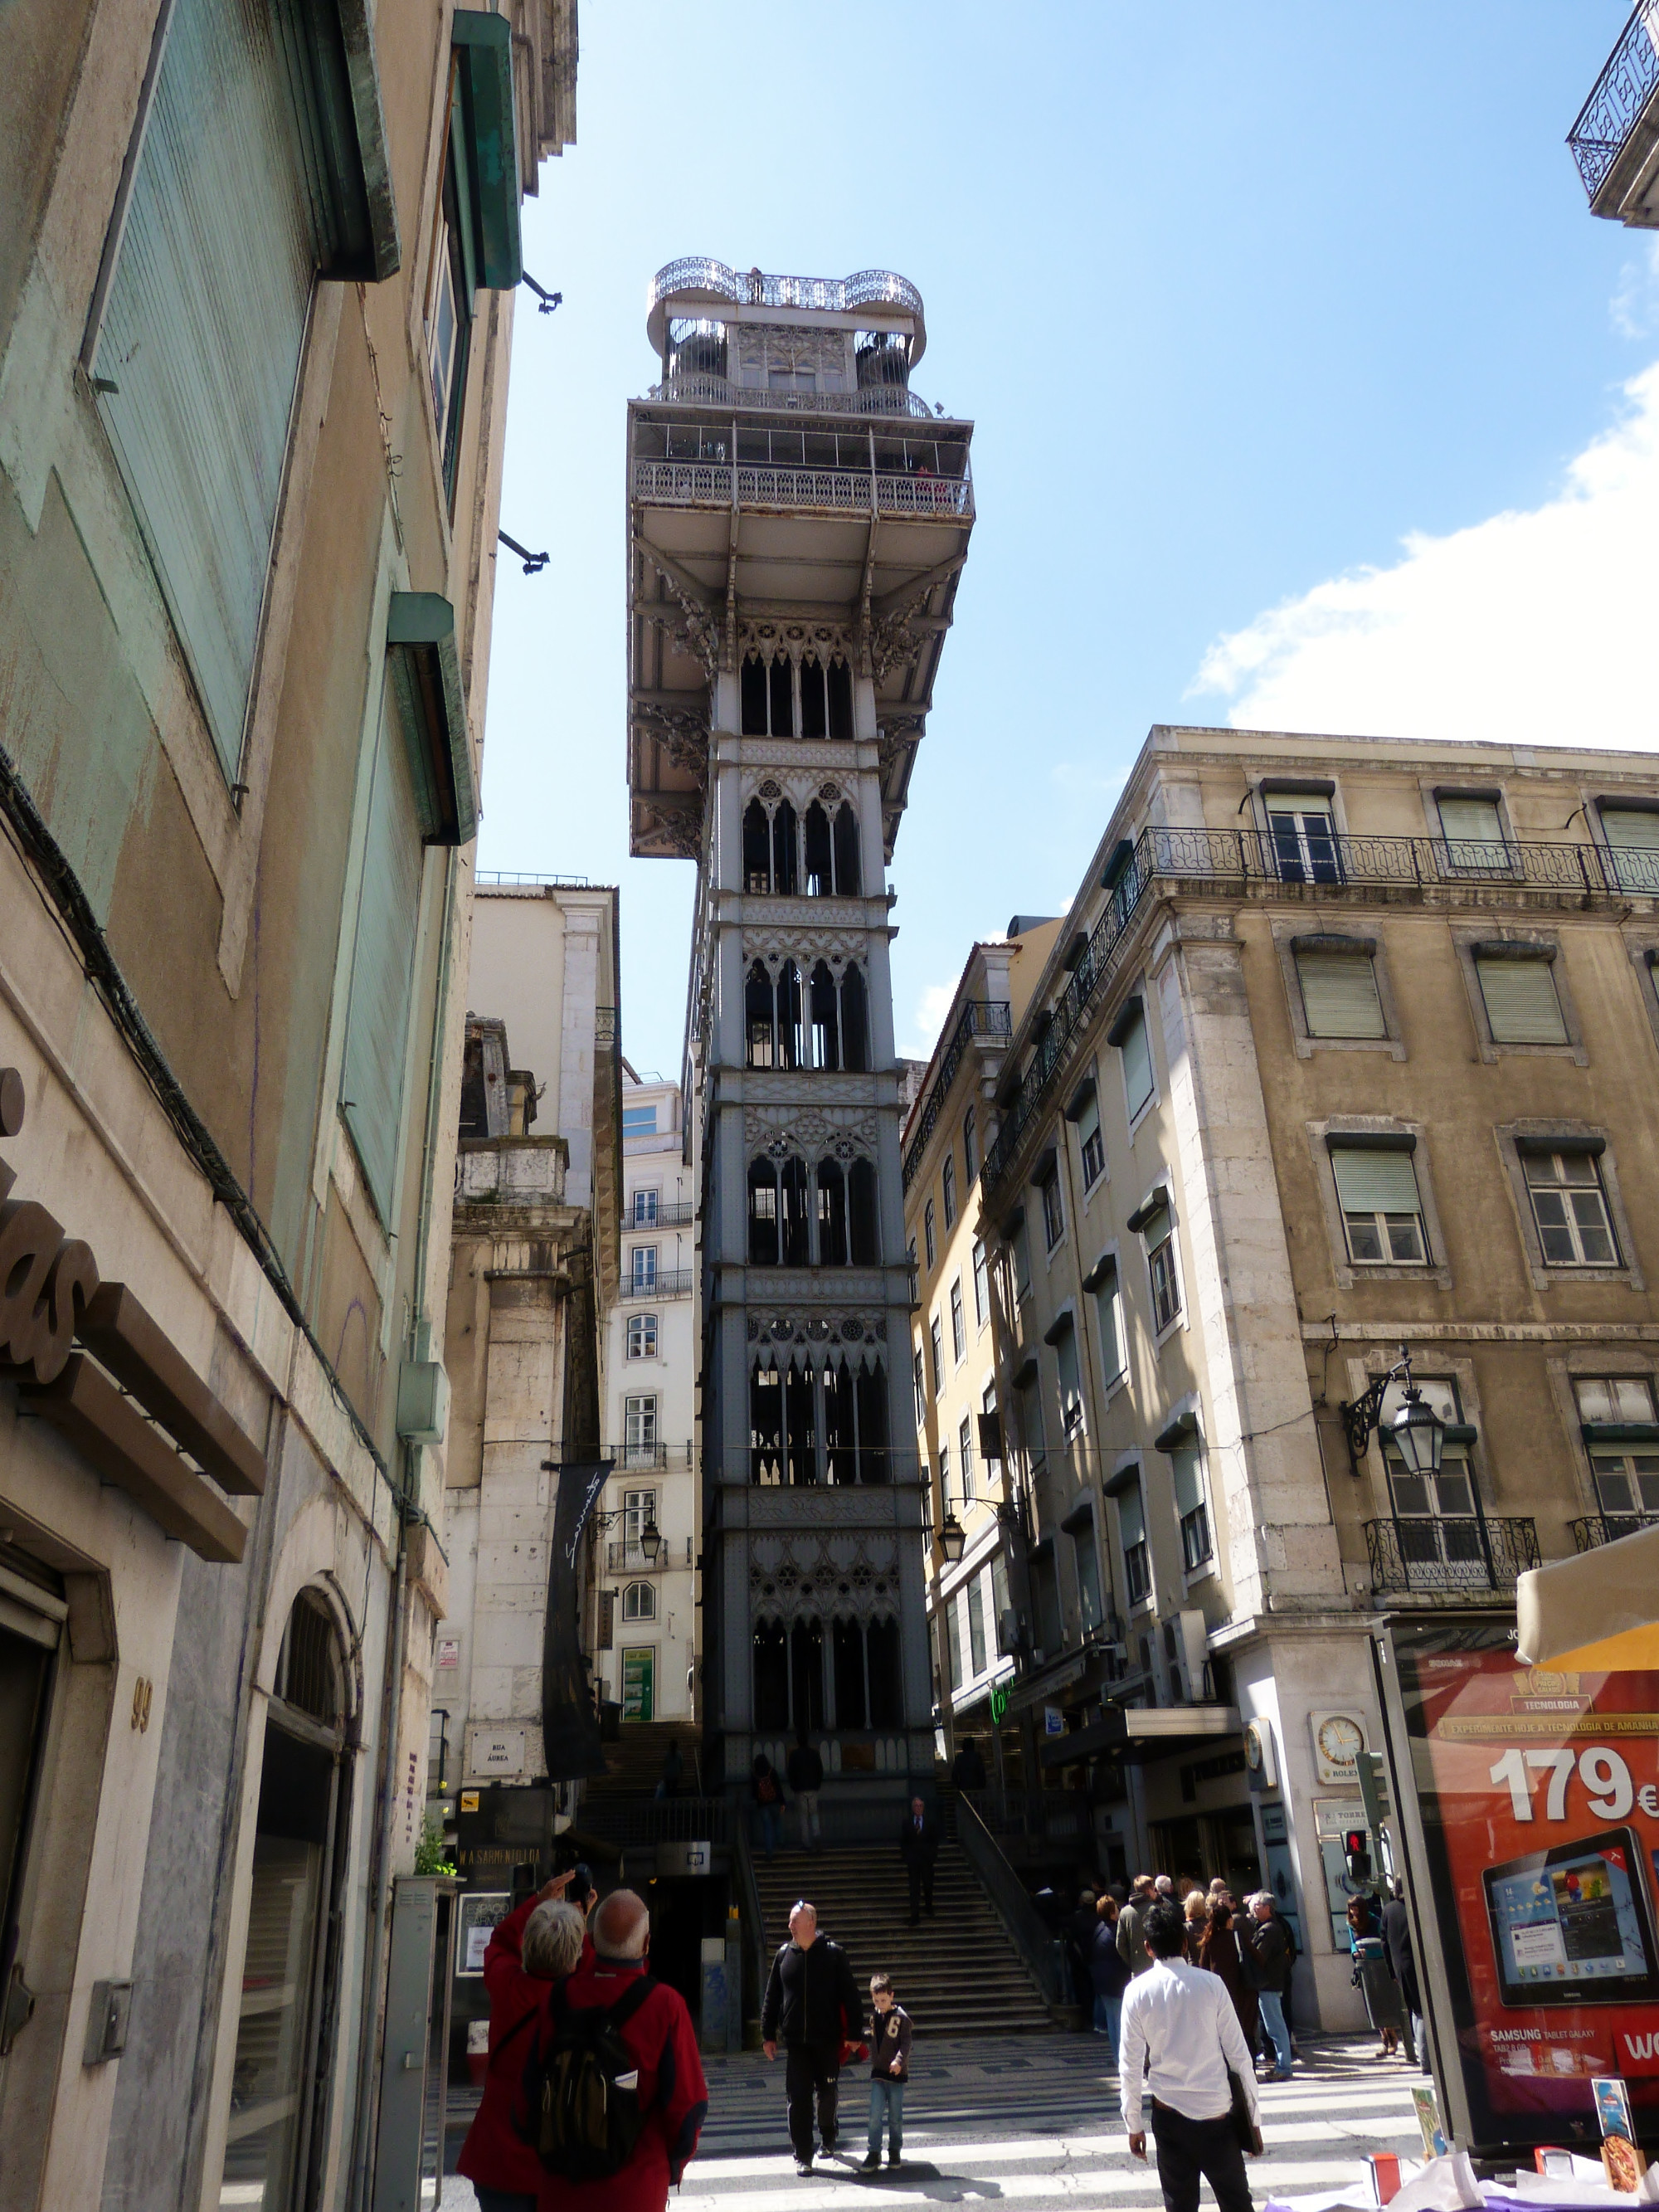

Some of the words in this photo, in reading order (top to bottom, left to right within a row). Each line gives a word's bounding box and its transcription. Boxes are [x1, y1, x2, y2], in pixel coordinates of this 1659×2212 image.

[131, 1676, 153, 1734] 99
[1525, 1700, 1579, 1710] TECNOLOGIA
[1452, 1725, 1513, 1734] EXPERIMENTE
[1515, 1724, 1535, 1733] HOJE
[1548, 1722, 1602, 1732] TECNOLOGIA
[1604, 1722, 1616, 1731] DE
[487, 1753, 508, 1761] ÁUREA
[888, 2016, 901, 2038] 6
[1491, 2029, 1541, 2041] SAMSUNG
[1544, 2031, 1567, 2039] TABLET
[1569, 2029, 1595, 2038] GALAXY
